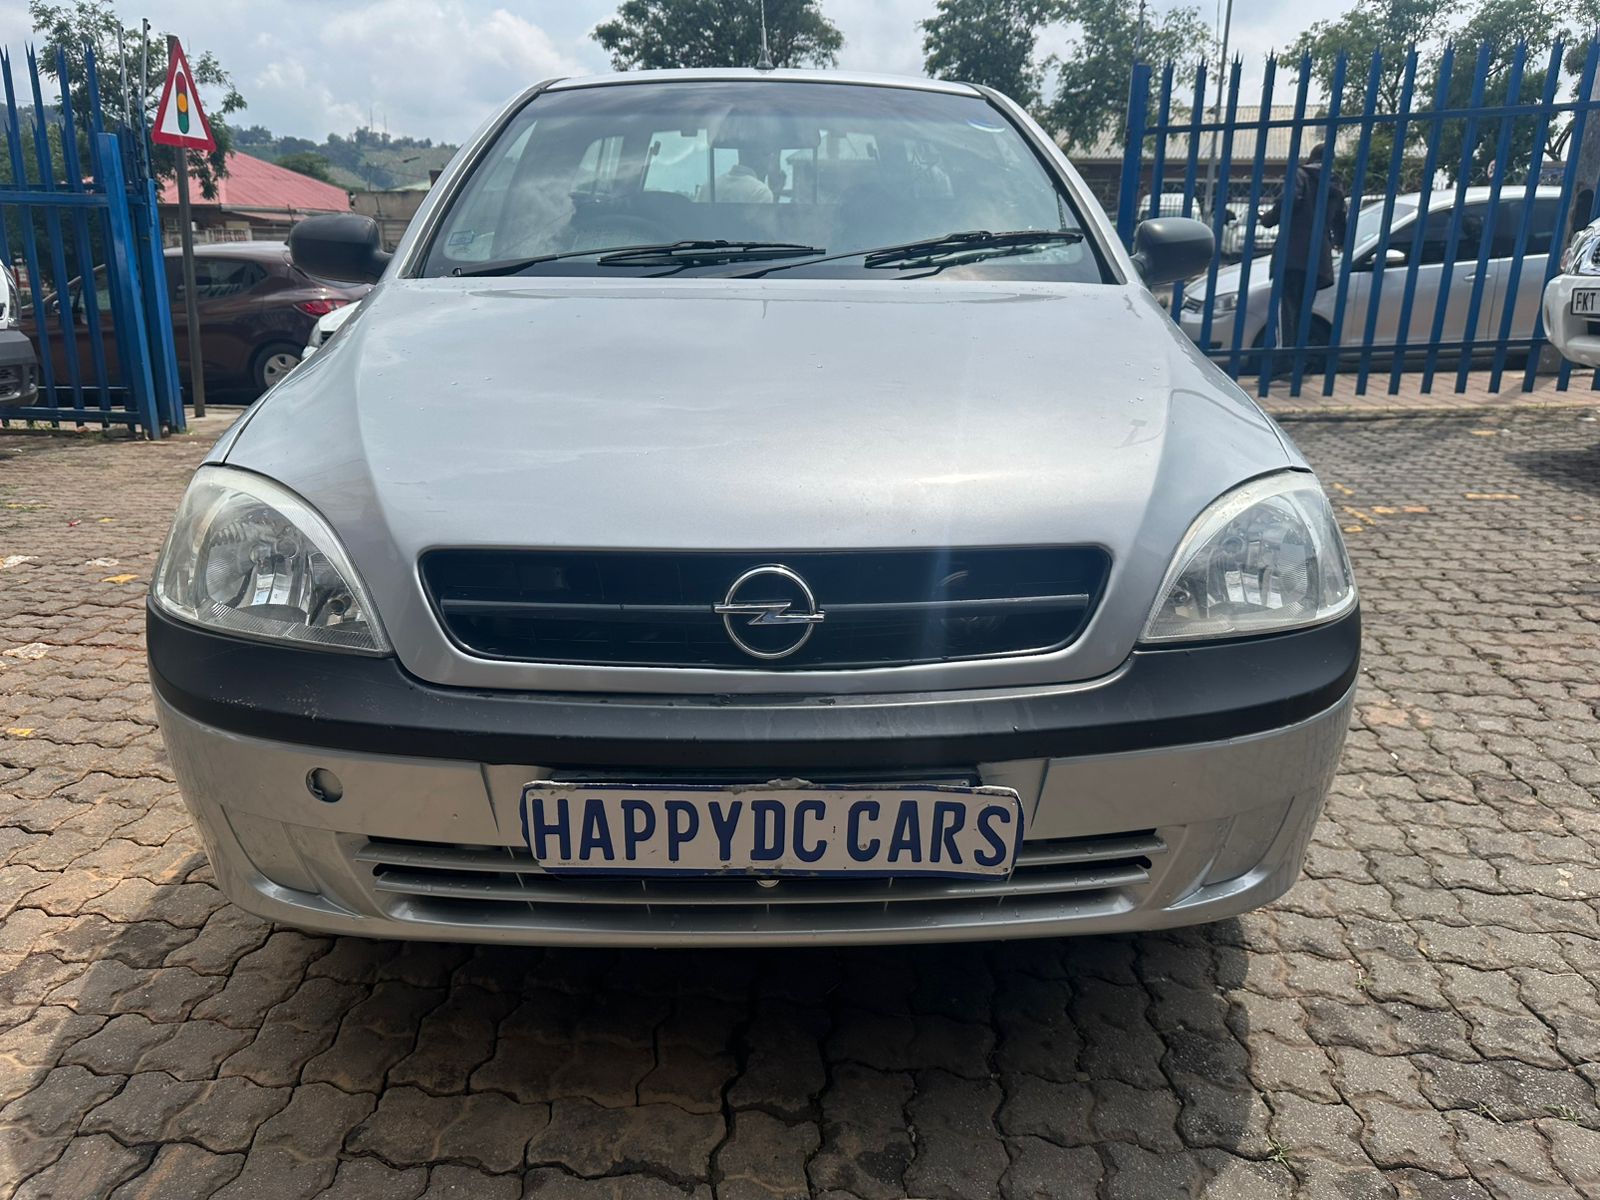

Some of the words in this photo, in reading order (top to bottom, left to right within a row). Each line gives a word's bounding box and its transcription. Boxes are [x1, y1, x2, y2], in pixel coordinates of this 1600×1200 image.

[1575, 292, 1597, 311] FKT
[532, 798, 828, 863] HAPPYDC
[847, 800, 1011, 867] CARS
